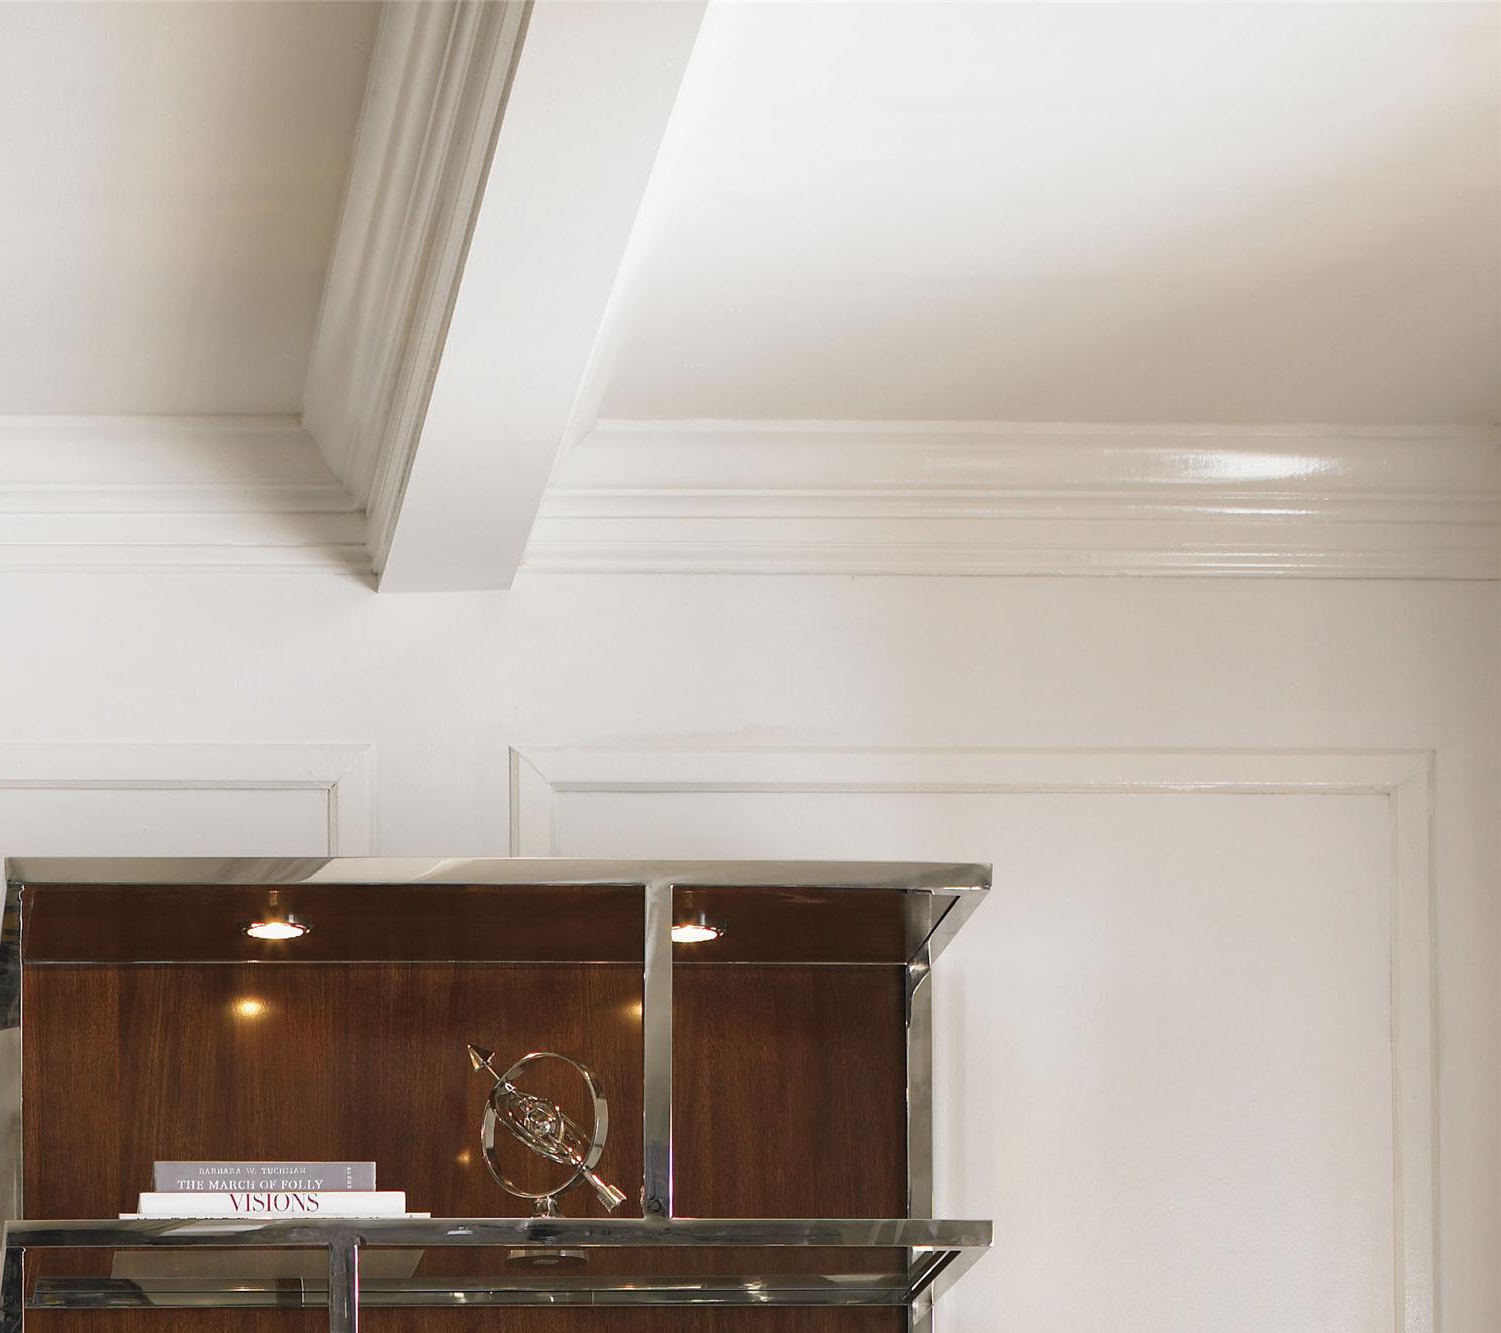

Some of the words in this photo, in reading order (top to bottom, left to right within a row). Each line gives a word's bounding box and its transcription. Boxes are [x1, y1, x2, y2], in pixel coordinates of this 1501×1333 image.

[177, 1179, 205, 1190] THE
[209, 1179, 255, 1190] MARCH
[259, 1179, 277, 1190] OF
[280, 1179, 324, 1190] FOLLY
[229, 1192, 320, 1213] VISIONS
